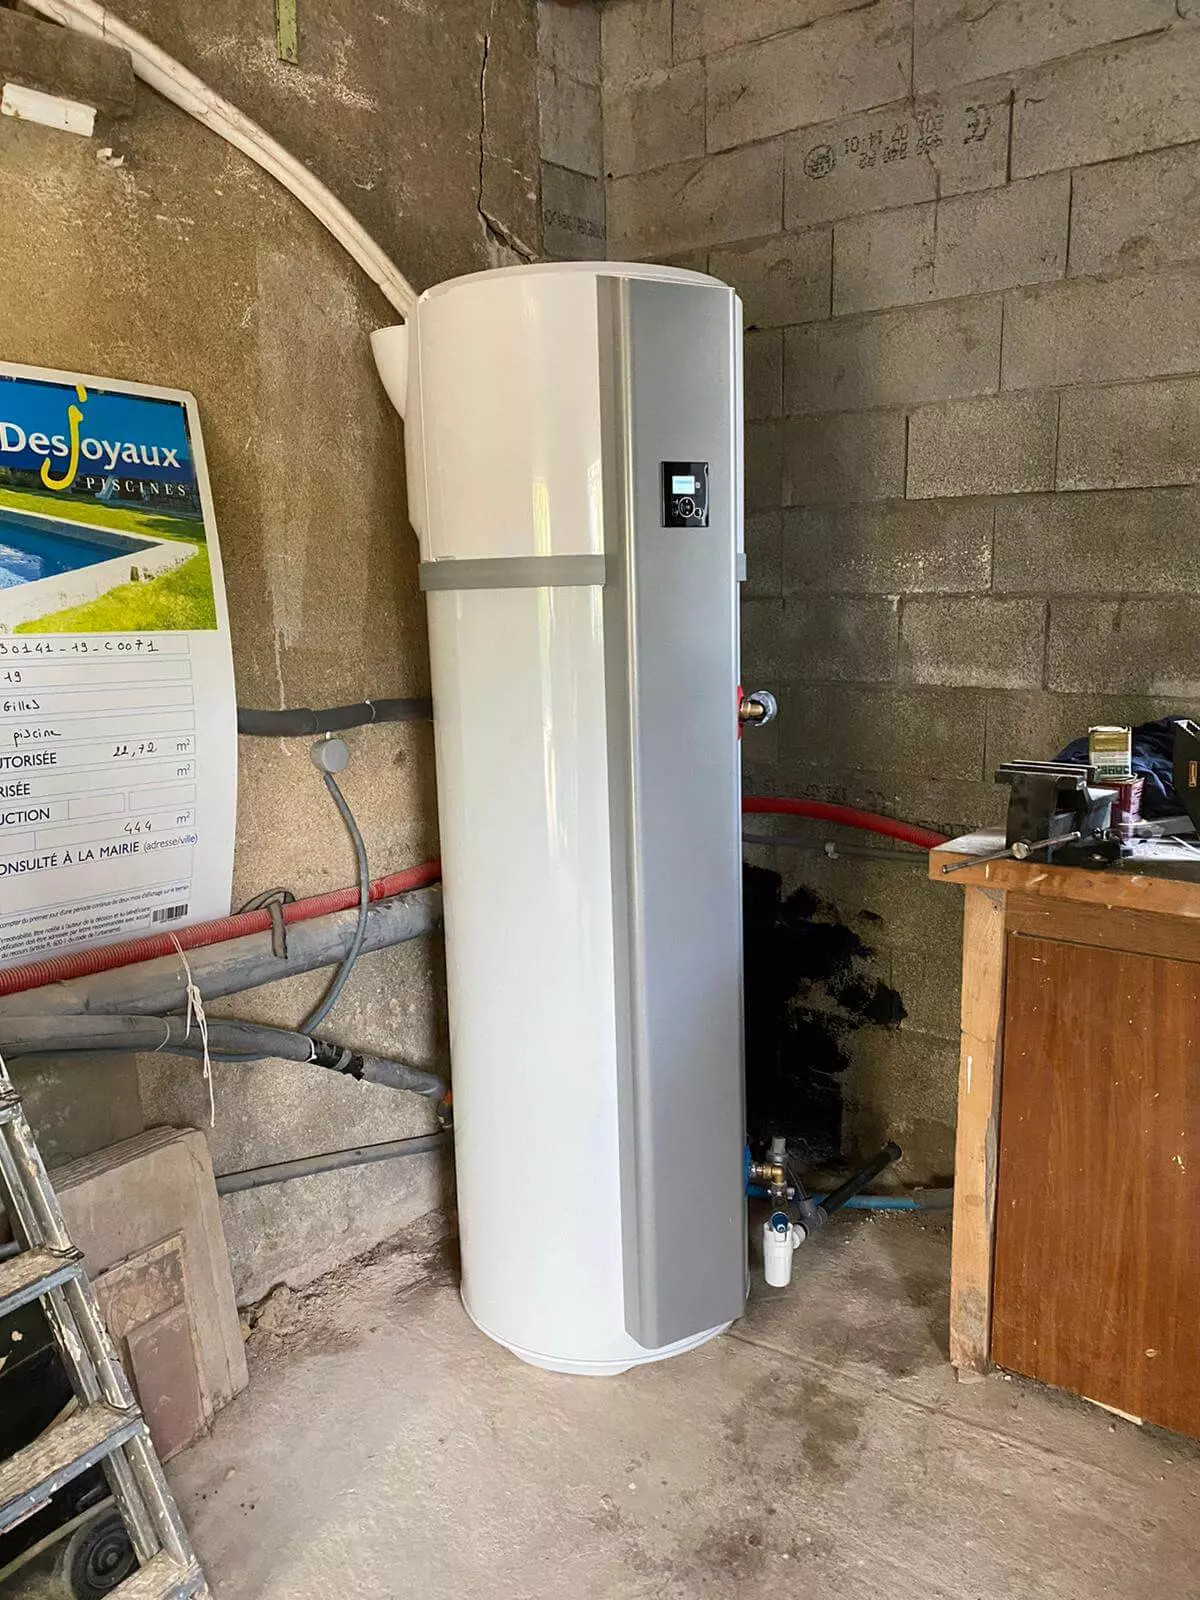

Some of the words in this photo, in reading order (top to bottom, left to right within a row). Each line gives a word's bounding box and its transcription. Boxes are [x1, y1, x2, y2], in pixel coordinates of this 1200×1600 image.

[86, 476, 186, 496] PISCINES
[4, 670, 22, 683] 19
[3, 699, 40, 712] Gilles
[13, 728, 62, 748] piscine
[123, 821, 152, 835] 444
[78, 849, 95, 862] LA
[100, 841, 140, 858] MAIRIE
